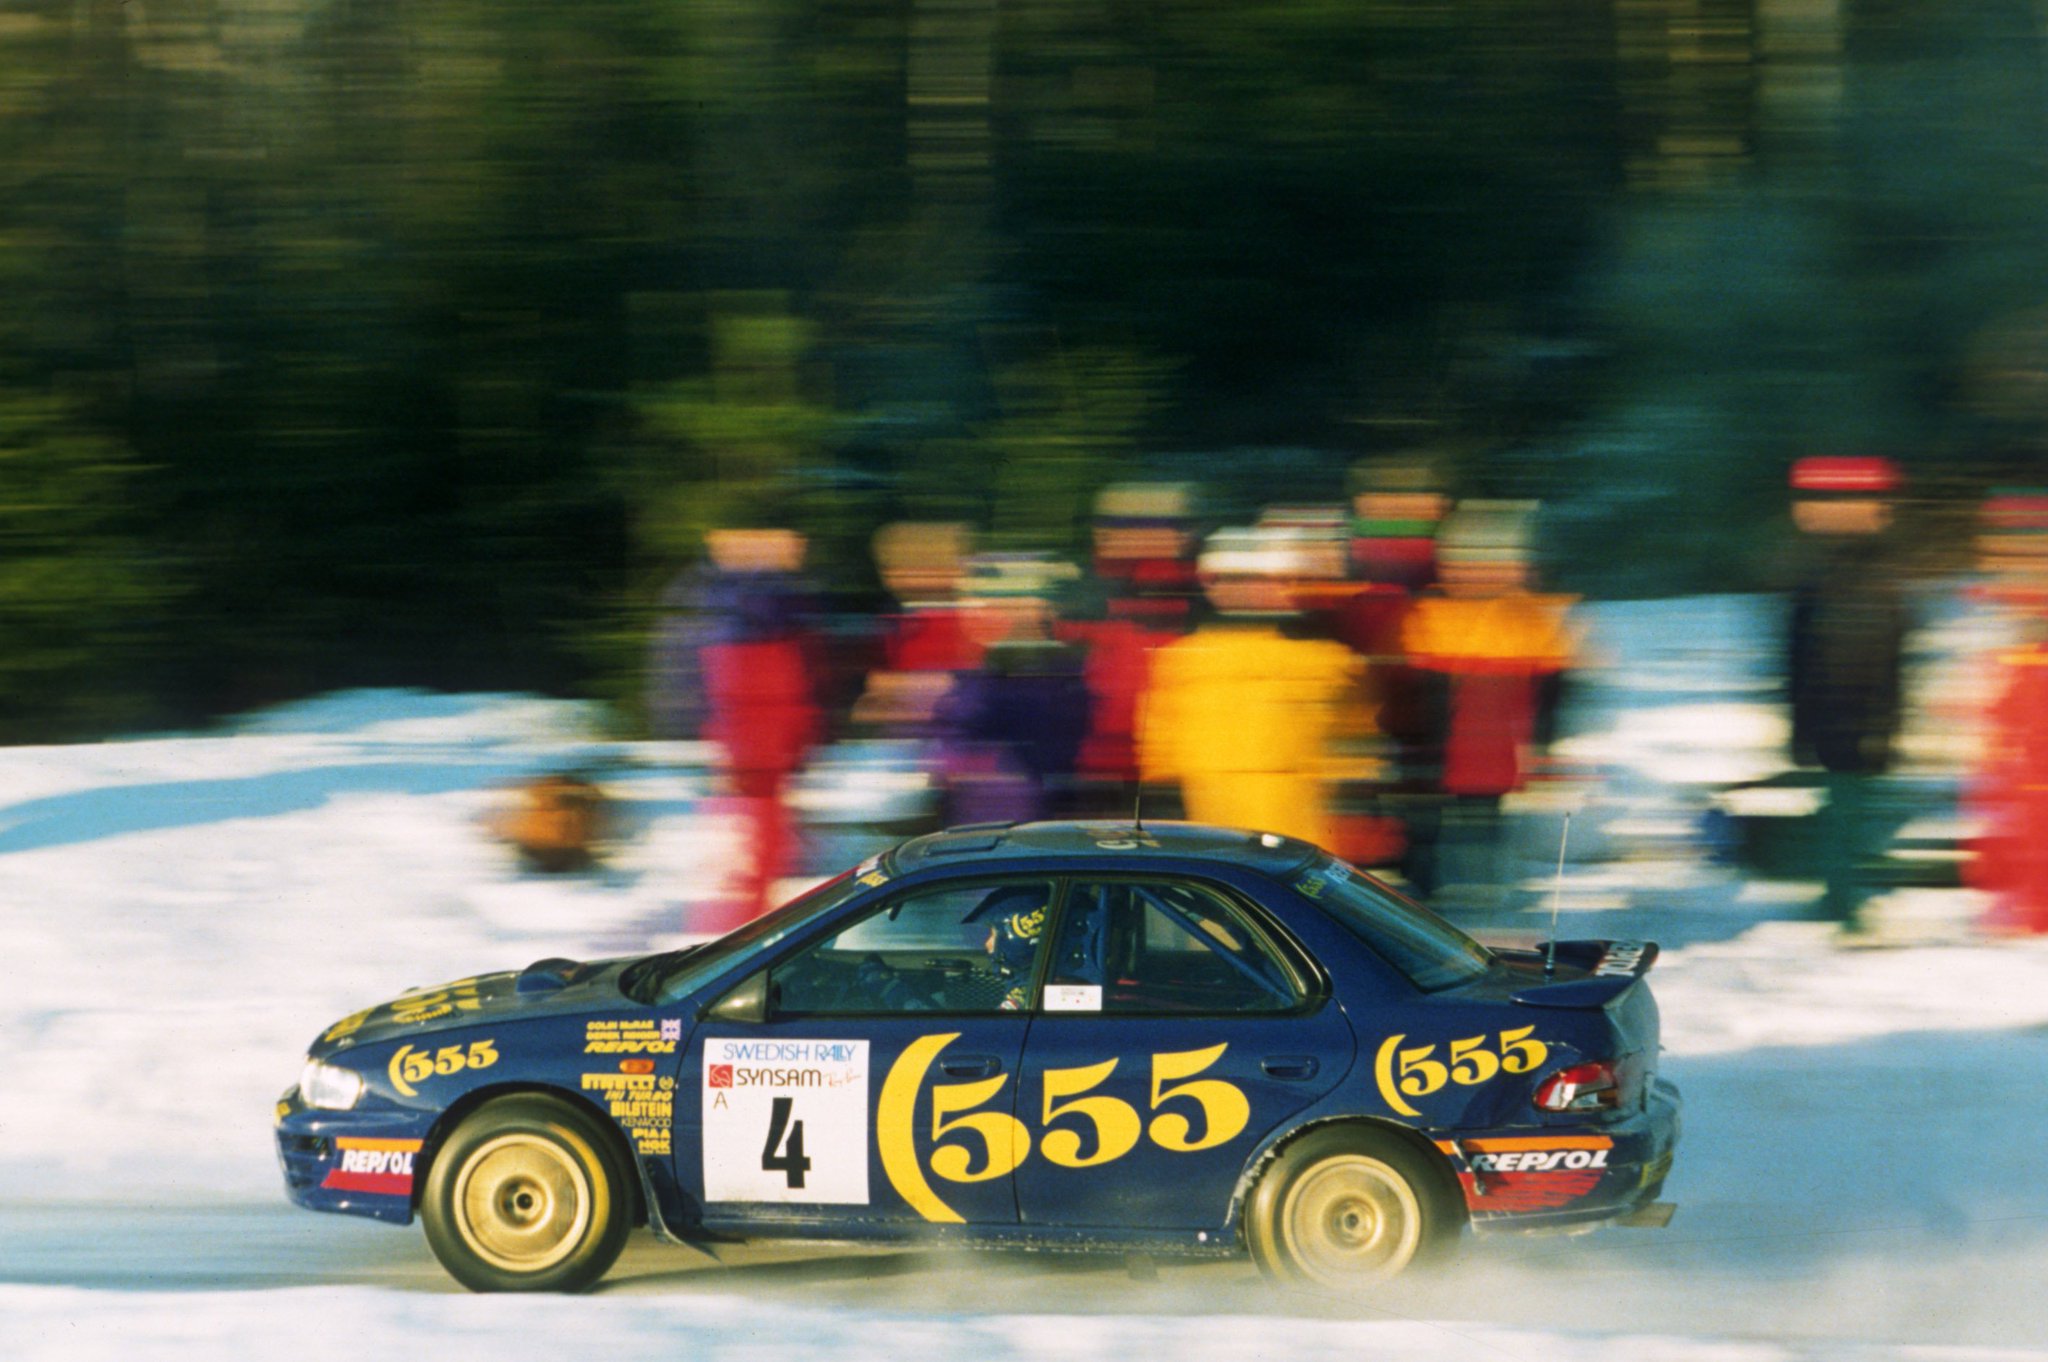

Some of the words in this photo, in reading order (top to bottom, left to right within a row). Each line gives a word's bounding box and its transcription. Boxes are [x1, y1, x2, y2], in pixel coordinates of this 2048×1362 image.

[584, 1040, 677, 1054] REPSOL
[723, 1042, 809, 1061] SWEDISH
[814, 1043, 857, 1062] RALLY
[735, 1068, 822, 1087] SYNSAM
[627, 1090, 674, 1102] TURBO
[713, 1090, 729, 1110] A
[610, 1101, 673, 1117] BILSTEIN
[621, 1117, 672, 1128] KENWOOD
[632, 1128, 671, 1139] PIAA
[761, 1097, 811, 1189] 4
[342, 1149, 414, 1175] REPSOL
[1464, 1150, 1608, 1172] REPSOL
